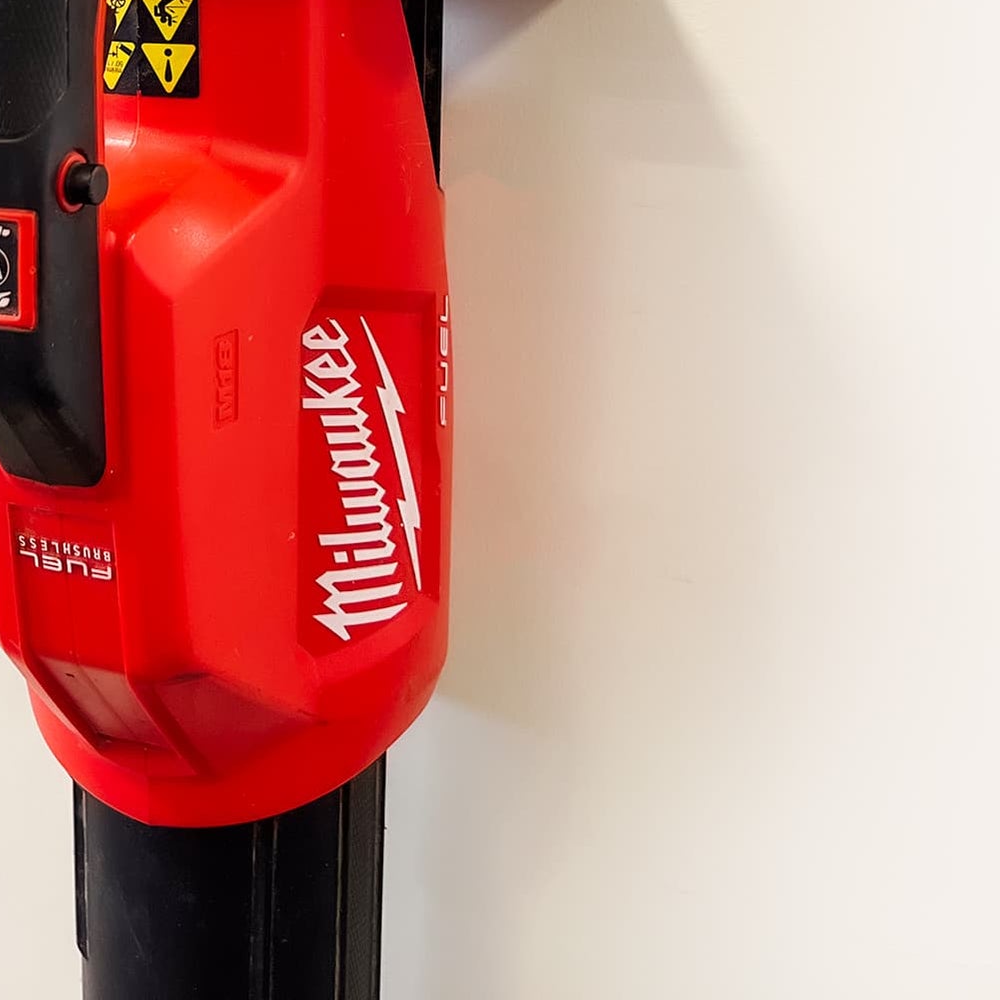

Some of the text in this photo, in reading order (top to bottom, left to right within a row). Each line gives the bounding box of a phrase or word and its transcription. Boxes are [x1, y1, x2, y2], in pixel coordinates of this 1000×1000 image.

[216, 338, 237, 422] M18
[440, 295, 448, 426] FUEL
[302, 317, 408, 641] Milwaukee
[18, 535, 111, 562] BRUSHLESS
[19, 549, 112, 580] FUEL
